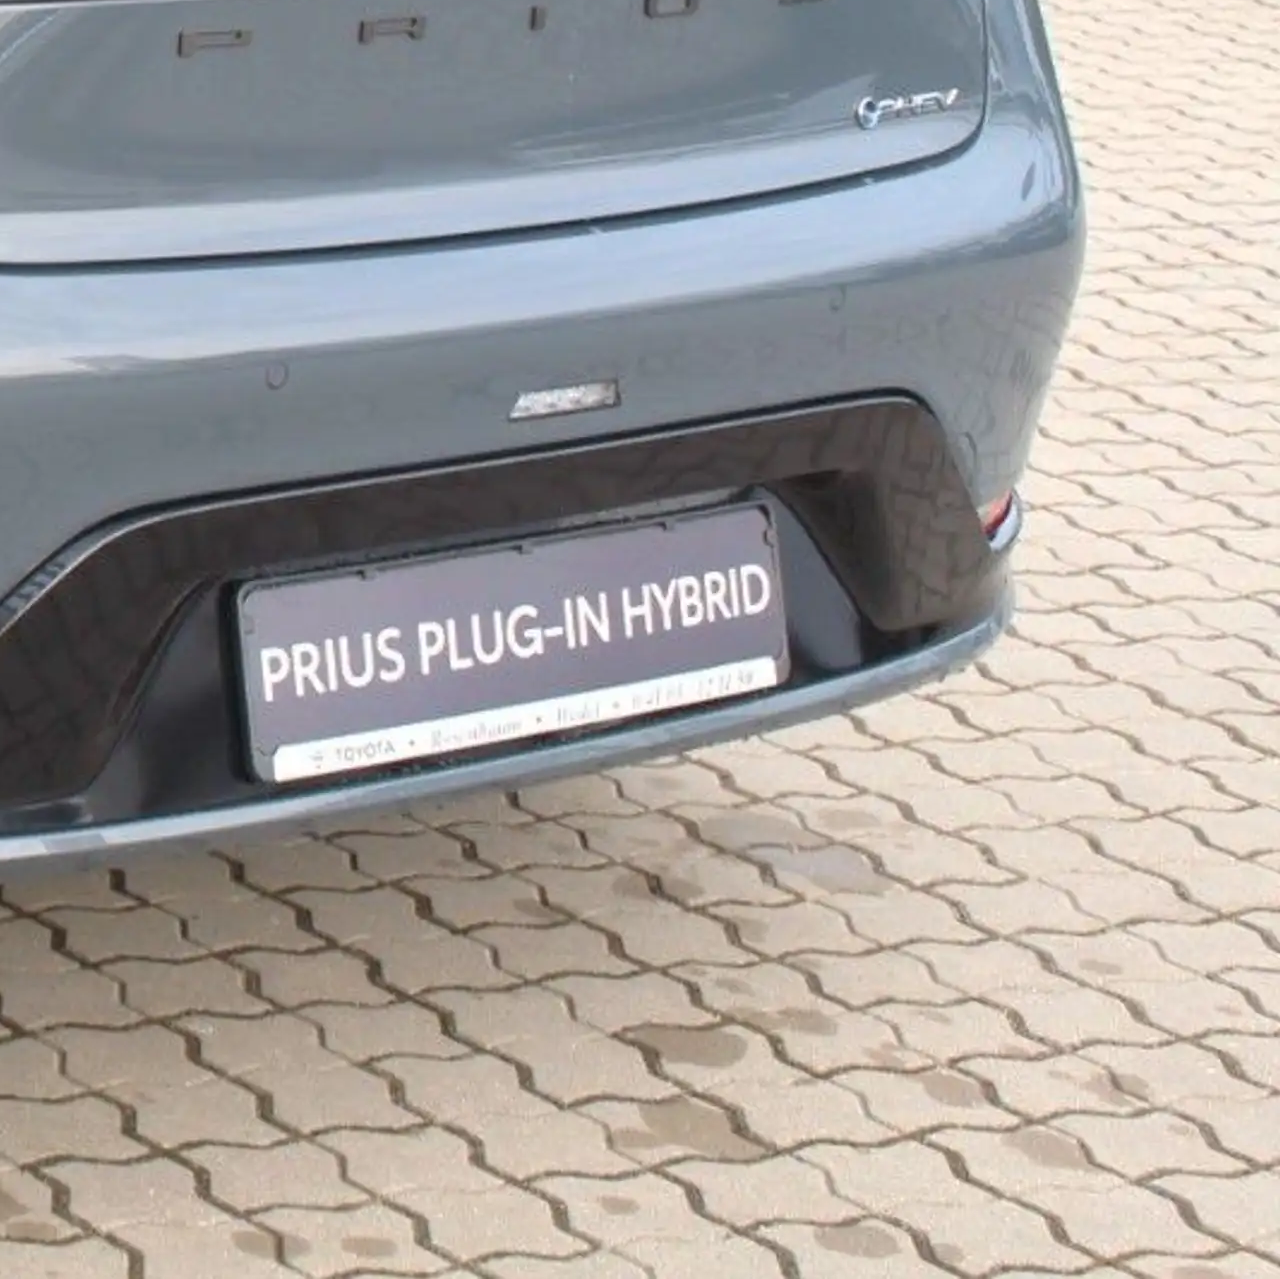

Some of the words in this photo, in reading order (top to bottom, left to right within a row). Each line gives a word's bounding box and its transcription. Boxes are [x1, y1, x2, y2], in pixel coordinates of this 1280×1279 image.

[878, 88, 959, 117] PHEV
[260, 626, 406, 703] PRIUS
[418, 591, 611, 676] PLUG-IN
[622, 564, 771, 638] HYBRID
